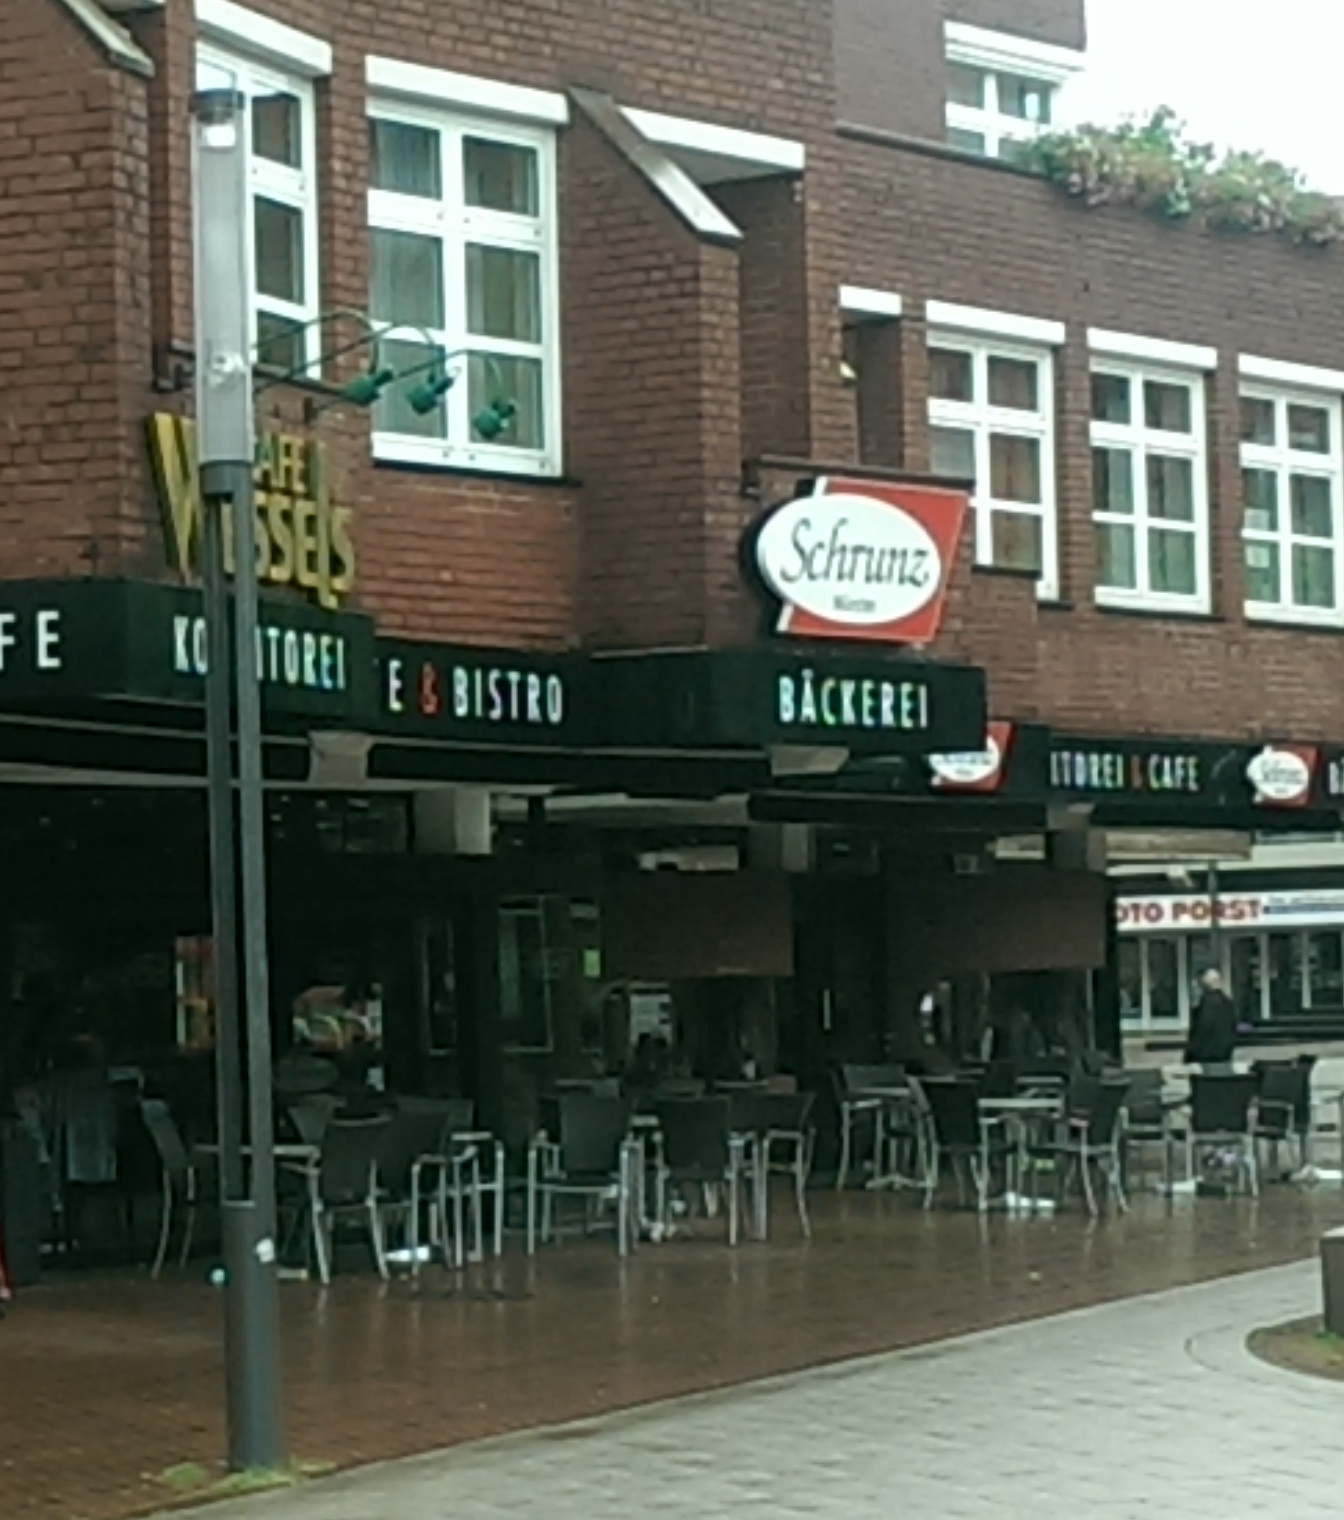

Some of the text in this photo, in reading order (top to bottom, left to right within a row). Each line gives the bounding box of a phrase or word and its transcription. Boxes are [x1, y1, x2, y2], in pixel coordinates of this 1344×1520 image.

[779, 517, 930, 588] Schrunz
[173, 615, 345, 689] KOITOREI
[421, 662, 439, 715] &
[453, 666, 563, 724] BISTRO
[778, 667, 928, 729] BÄCKEREI
[1148, 753, 1199, 791] CAFE
